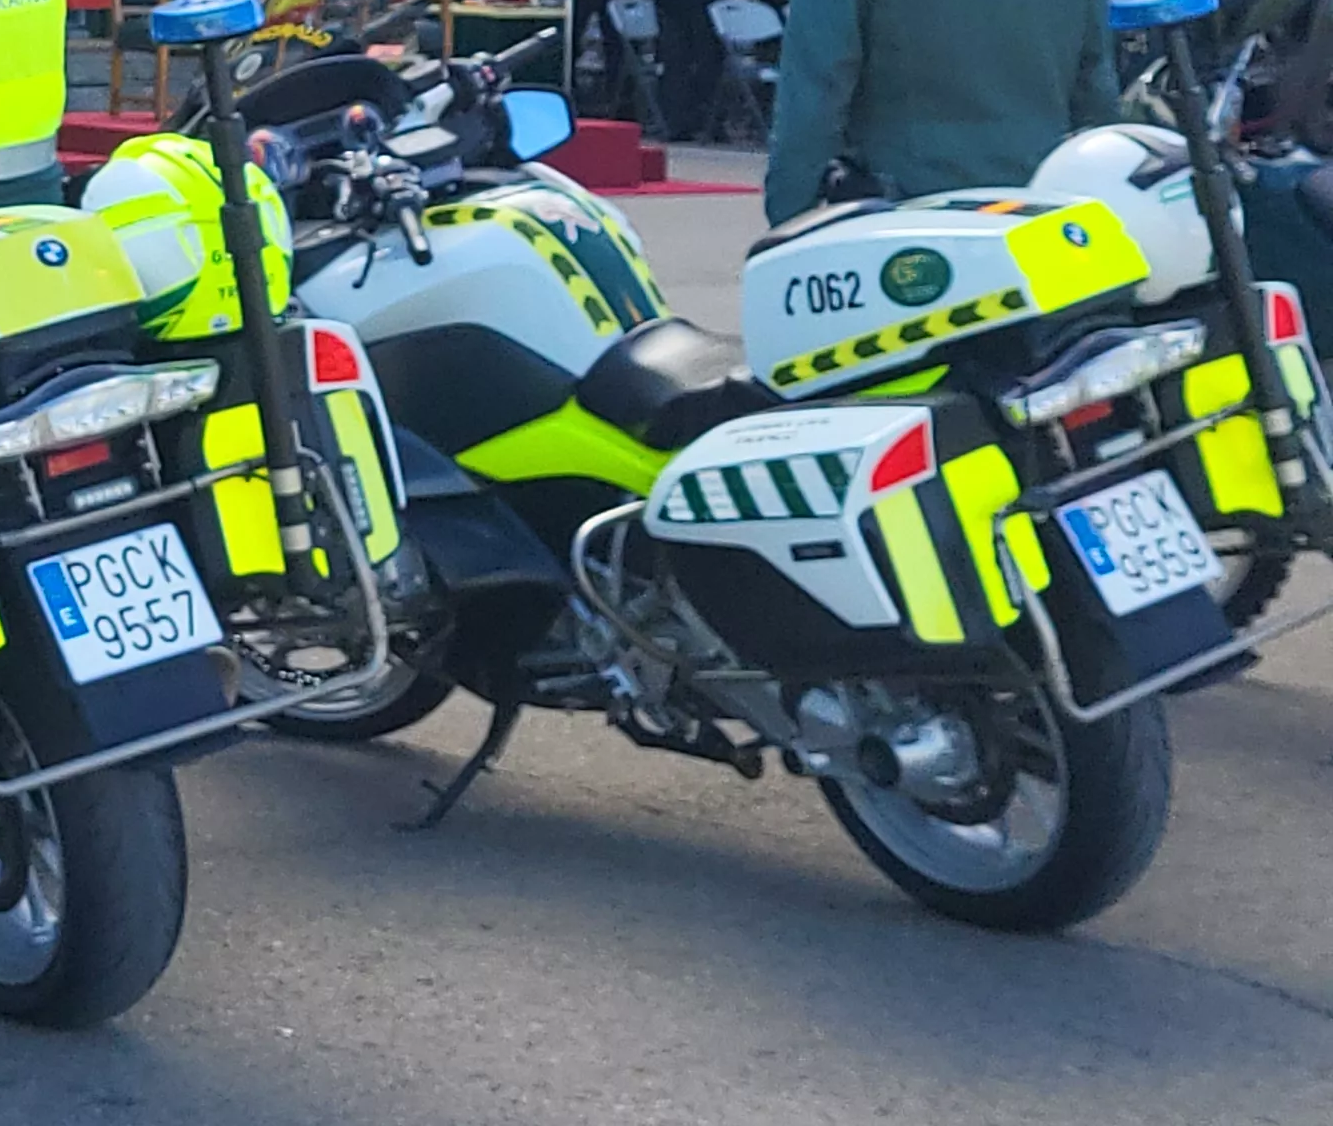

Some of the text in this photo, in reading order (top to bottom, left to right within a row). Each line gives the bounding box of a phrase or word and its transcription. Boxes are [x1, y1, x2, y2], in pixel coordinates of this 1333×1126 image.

[806, 271, 866, 314] 062
[66, 534, 186, 607] PGCK
[1120, 529, 1208, 593] 9559
[59, 606, 78, 627] E
[93, 589, 195, 660] 9557
